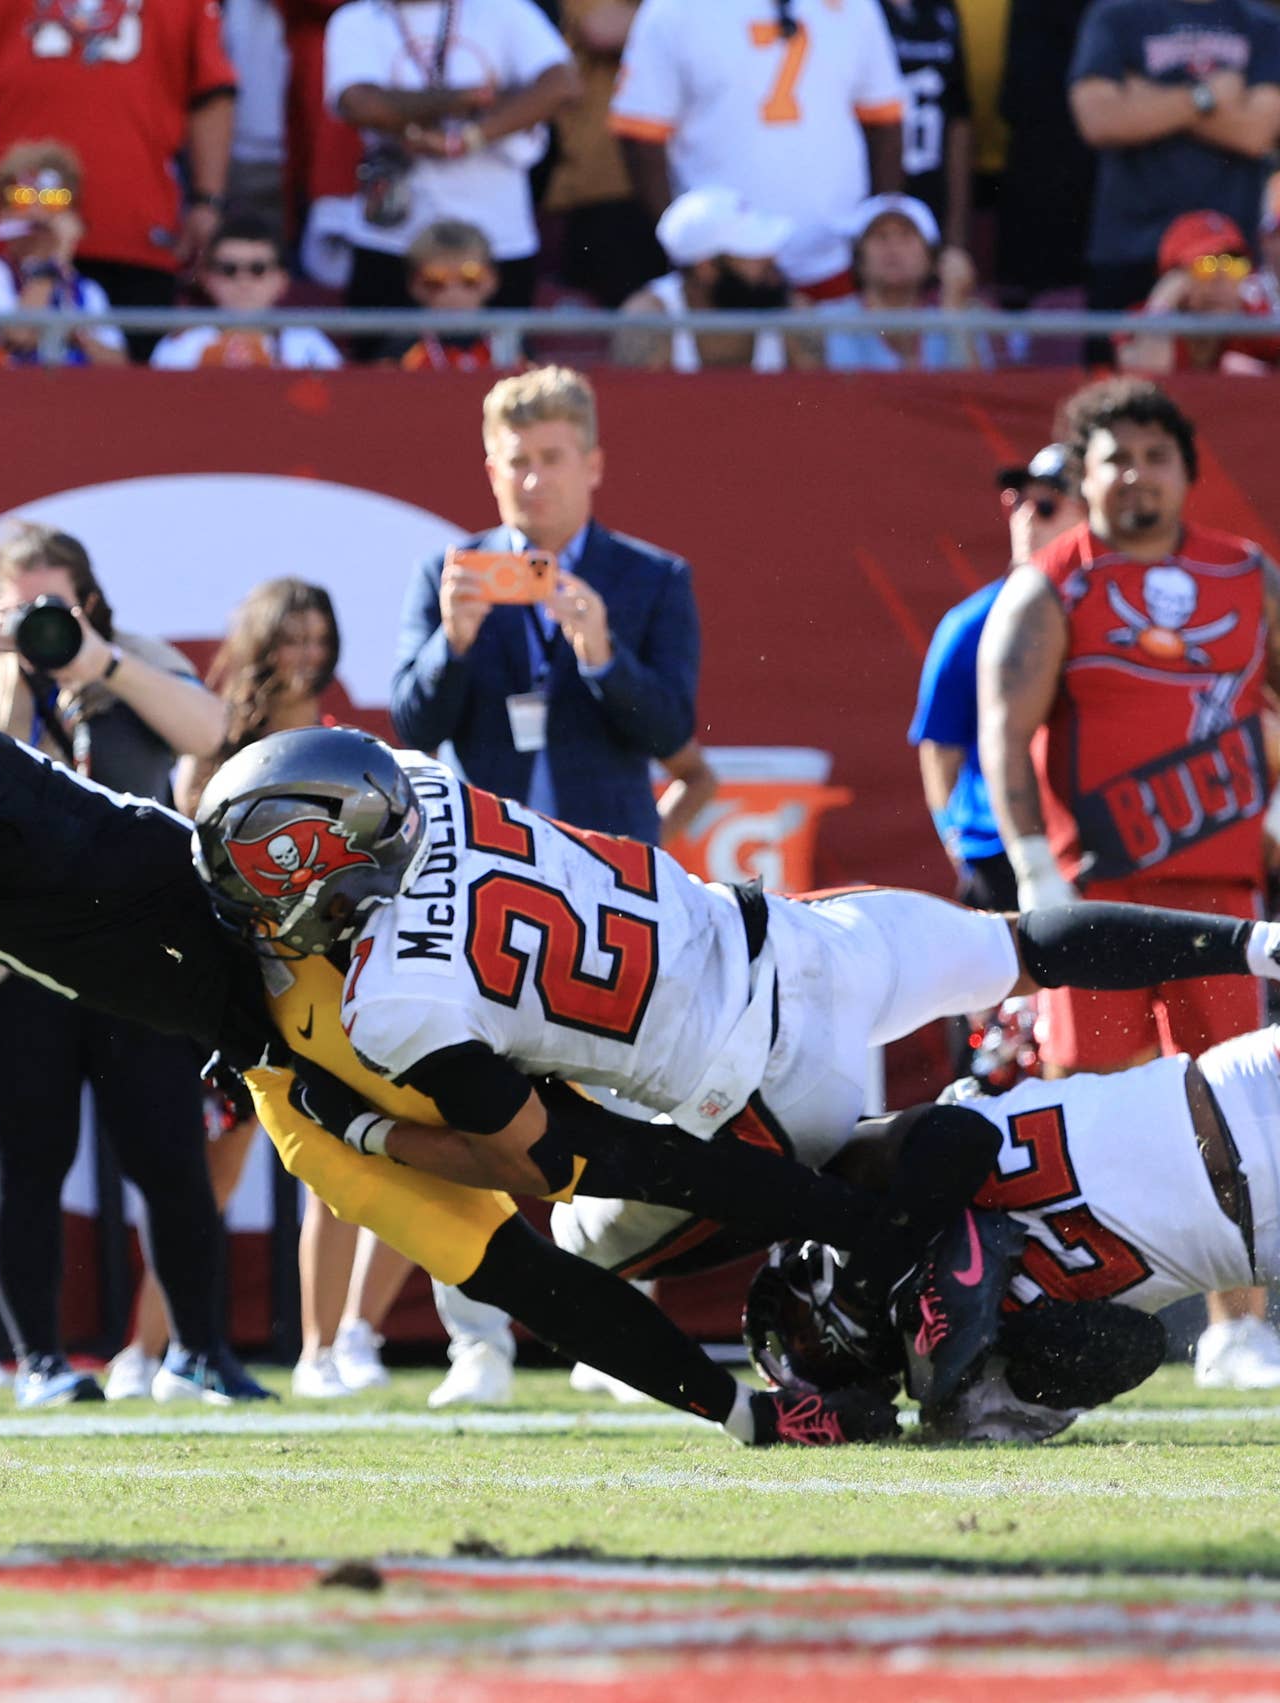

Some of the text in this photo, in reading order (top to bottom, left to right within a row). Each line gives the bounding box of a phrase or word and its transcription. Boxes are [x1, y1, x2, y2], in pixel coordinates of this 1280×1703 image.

[747, 18, 811, 123] 7
[1104, 724, 1264, 870] BUCS
[464, 781, 659, 1047] 27
